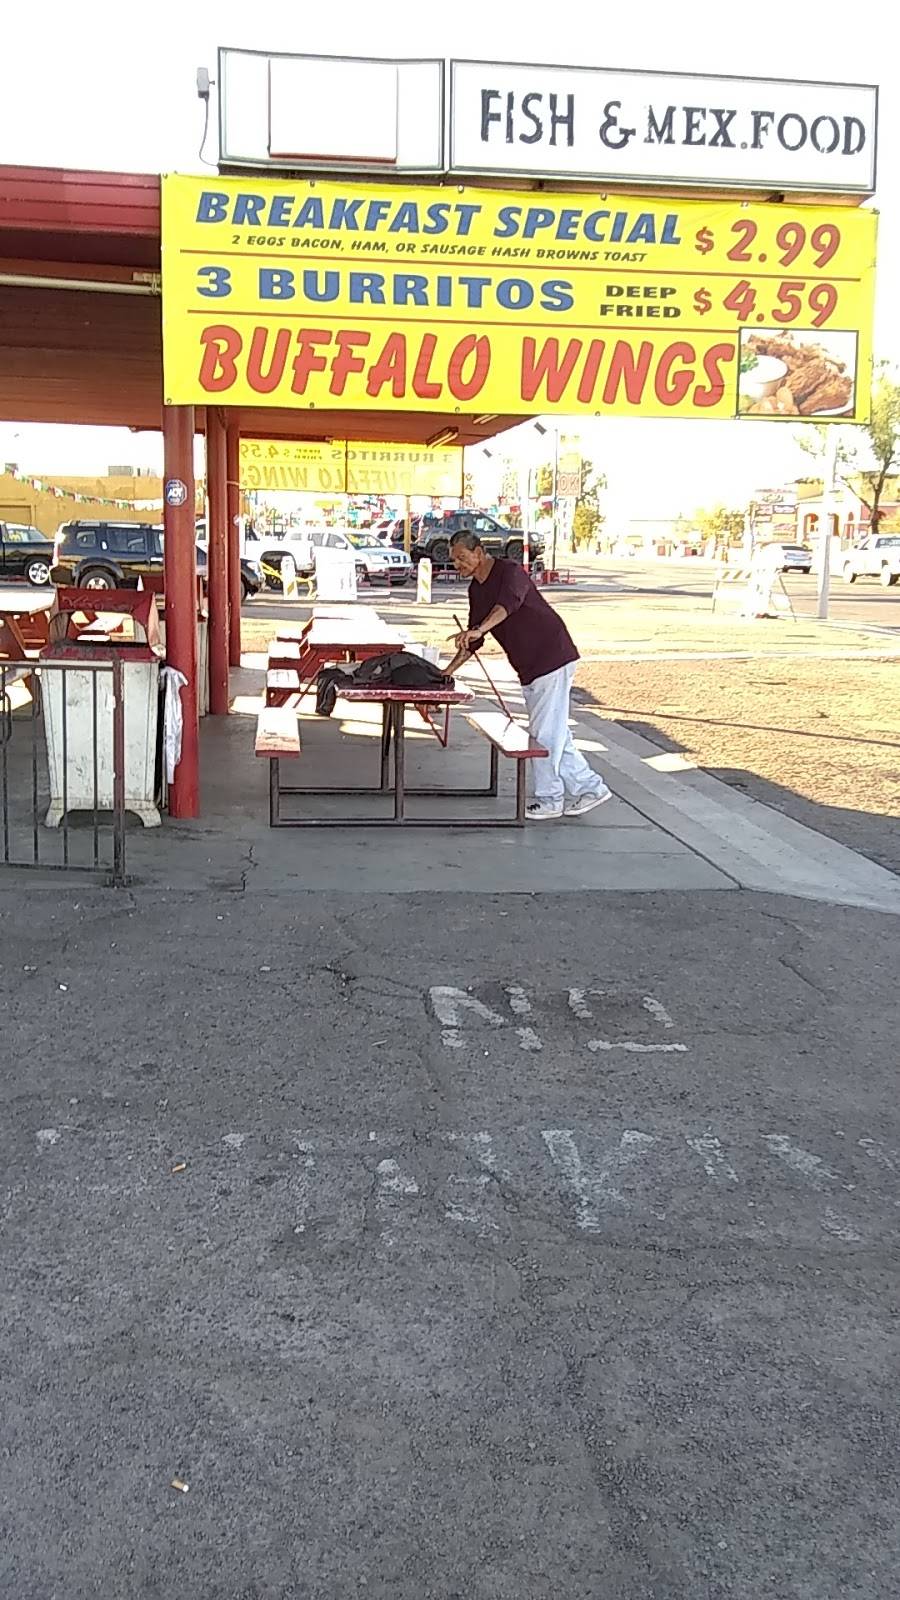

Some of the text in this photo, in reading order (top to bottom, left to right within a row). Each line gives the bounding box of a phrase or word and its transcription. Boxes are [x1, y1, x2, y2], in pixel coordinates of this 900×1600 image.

[480, 89, 575, 147] FISH
[599, 100, 637, 150] &
[197, 192, 481, 234] BREAKFAST
[496, 207, 681, 243] SPECIAL
[728, 219, 840, 268] 2.99
[232, 235, 648, 262] 2 EGGS BACON, HAM, OR SAUSAGE HASH BROWNS TOAST
[198, 266, 575, 311] 3 BURRITOS
[599, 304, 682, 318] FRIED
[605, 285, 678, 299] DEEP
[723, 280, 838, 328] 4.59
[199, 325, 735, 407] BUFFALO WINGS
